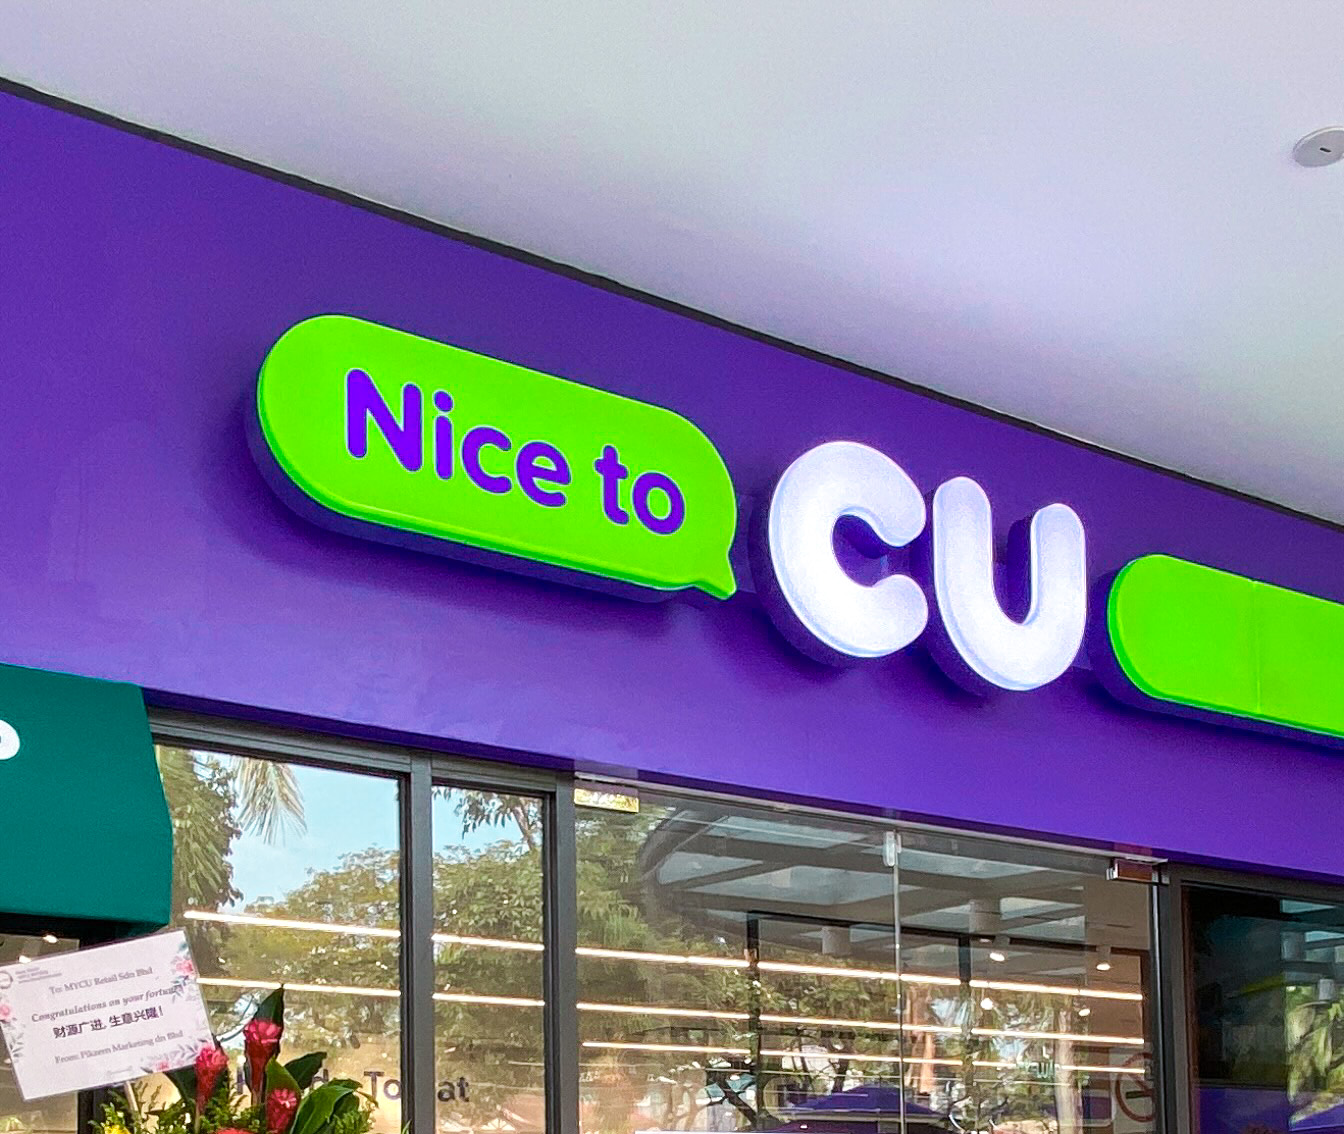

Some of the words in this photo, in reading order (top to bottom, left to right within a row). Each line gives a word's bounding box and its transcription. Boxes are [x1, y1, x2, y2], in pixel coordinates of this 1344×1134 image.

[345, 367, 572, 509] Nice
[595, 444, 686, 536] to
[768, 439, 1088, 692] CU
[94, 974, 118, 986] Retail
[31, 1000, 107, 1023] Congratulations
[122, 993, 144, 1006] your
[112, 1038, 155, 1052] Marketing
[437, 1075, 471, 1103] at
